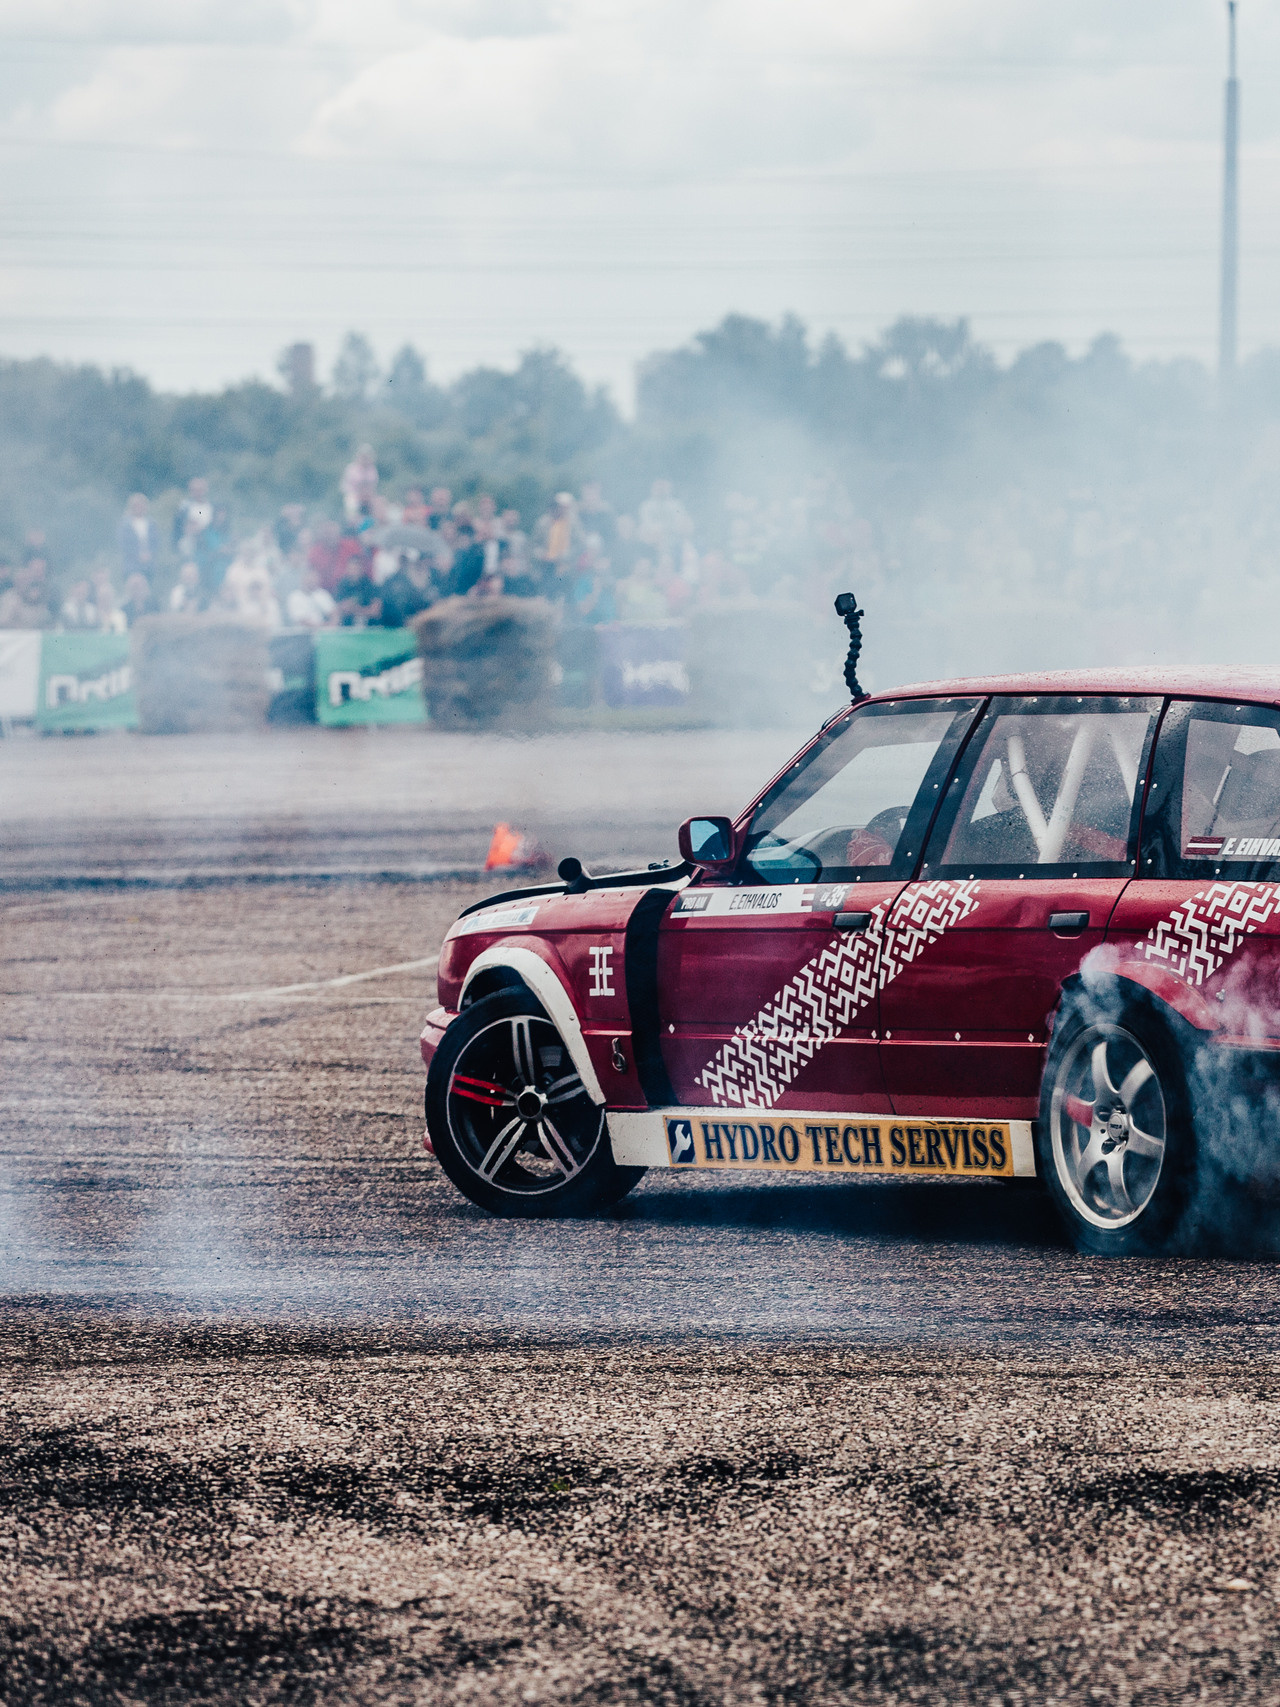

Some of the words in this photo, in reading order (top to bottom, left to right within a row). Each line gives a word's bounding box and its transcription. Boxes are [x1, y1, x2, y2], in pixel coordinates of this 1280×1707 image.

[729, 892, 782, 911] E.EIHVALDS
[702, 1123, 800, 1163] HYDRO
[805, 1124, 884, 1165] TECH
[890, 1125, 1008, 1169] SERVISS
